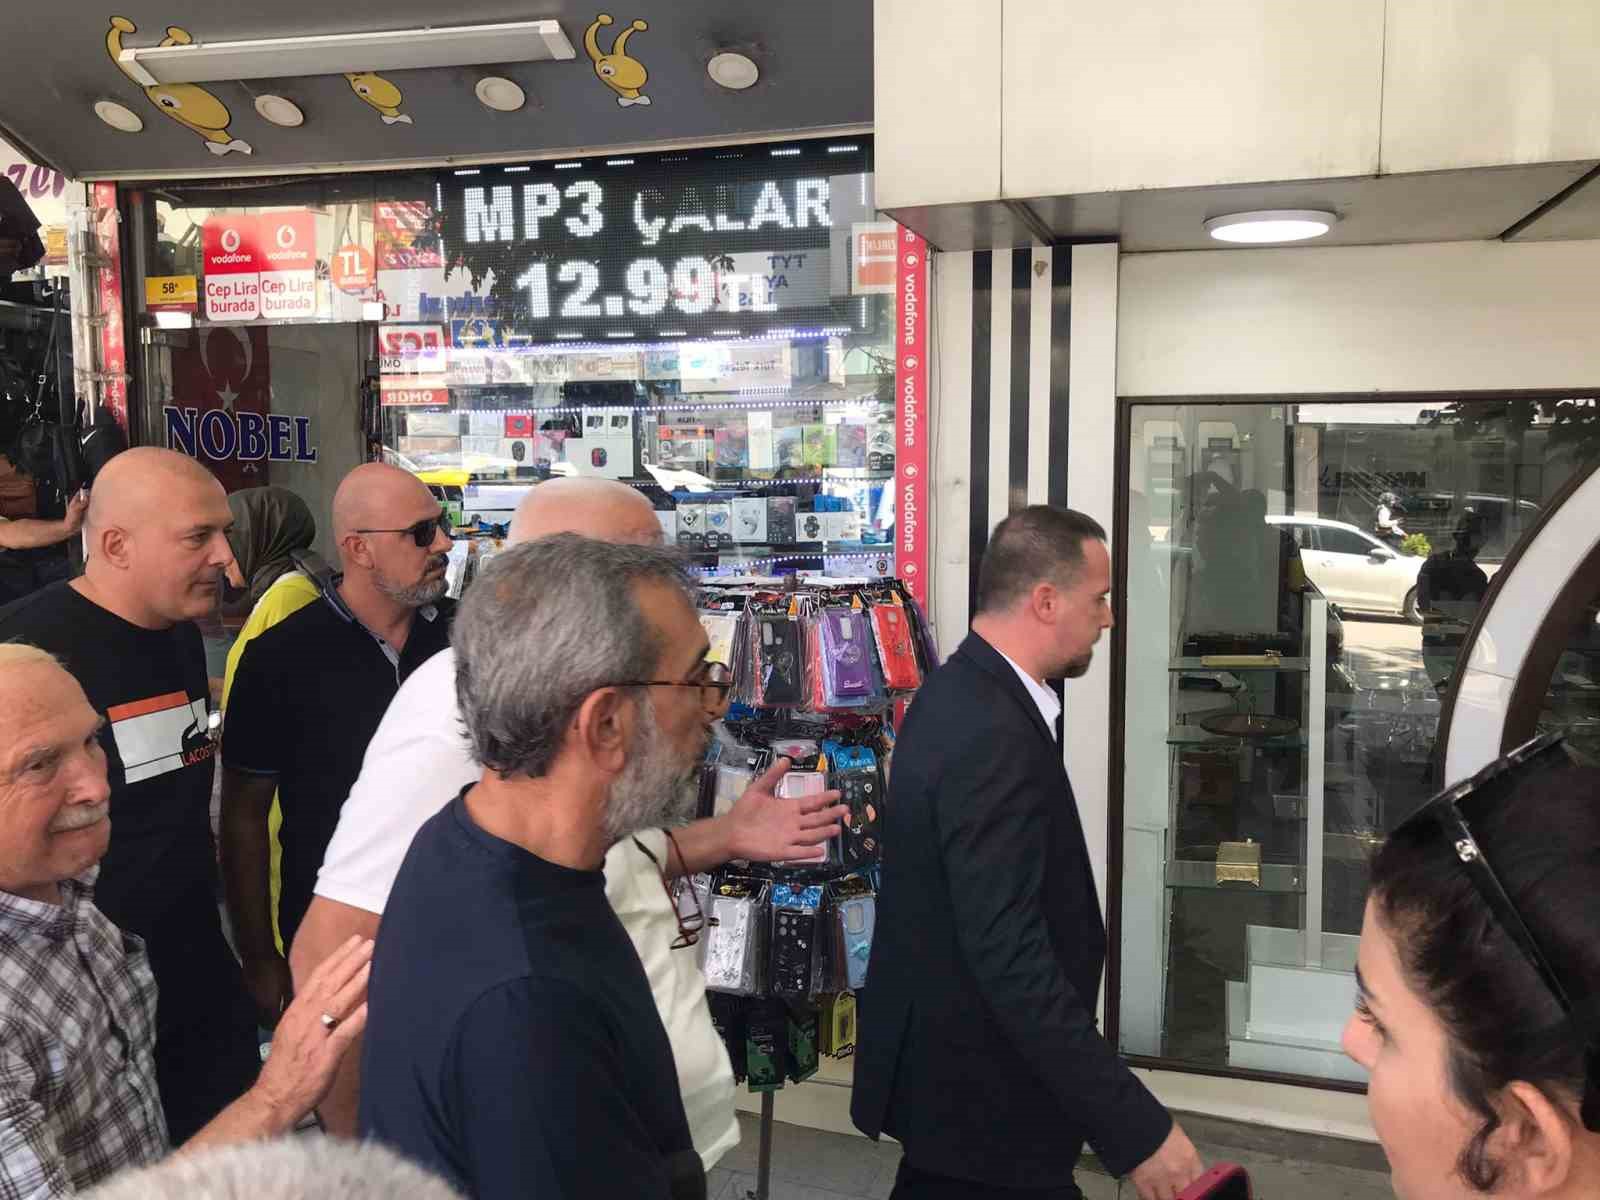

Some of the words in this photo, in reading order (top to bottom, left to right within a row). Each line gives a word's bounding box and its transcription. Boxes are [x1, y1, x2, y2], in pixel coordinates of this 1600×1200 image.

[464, 180, 604, 242] MP3
[633, 178, 832, 246] ÇALAR
[211, 254, 252, 265] vodafone
[266, 250, 308, 261] vodafone
[338, 251, 369, 276] TL
[207, 282, 231, 299] Cep
[234, 281, 258, 296] Lira
[262, 279, 286, 296] Cep
[289, 277, 313, 292] Lira
[211, 298, 256, 313] burada
[265, 295, 311, 311] burada
[904, 274, 918, 345] vodafone
[904, 376, 918, 448] vodafone
[163, 405, 317, 464] NOBEL
[904, 483, 918, 552] vodafone
